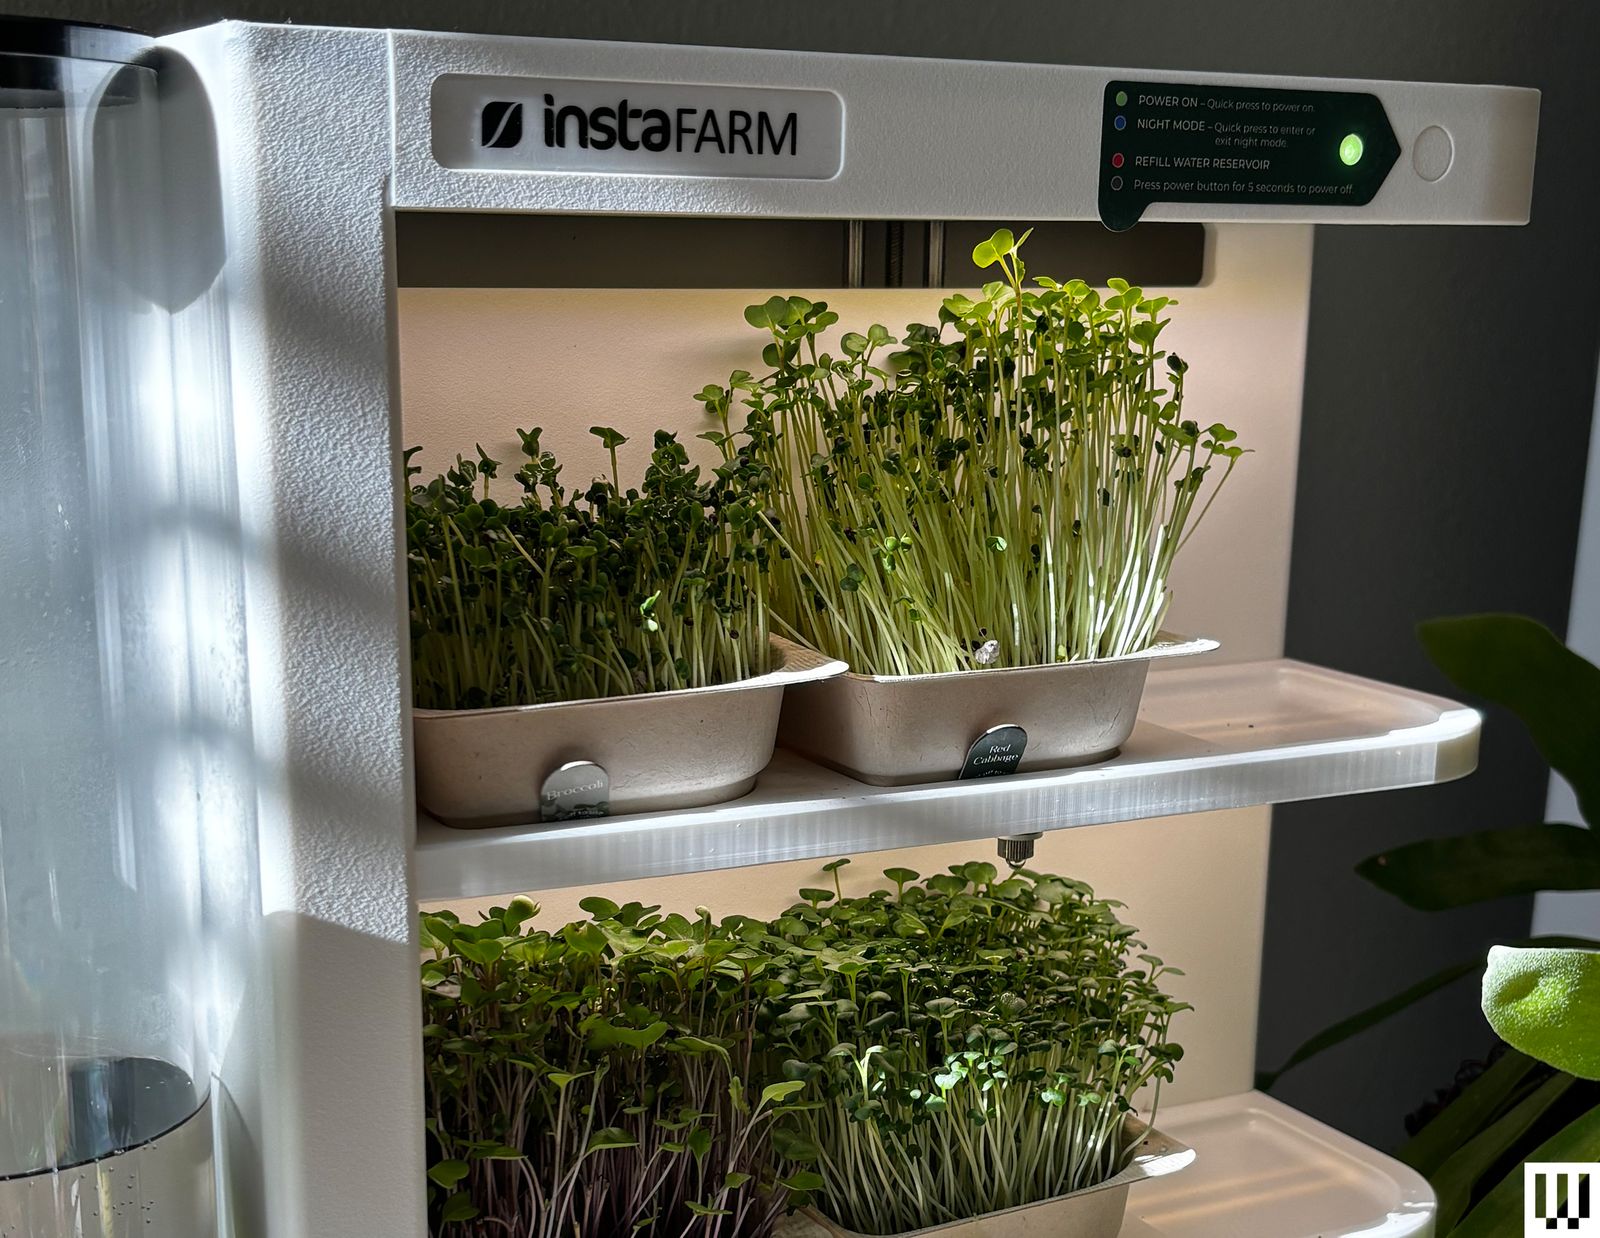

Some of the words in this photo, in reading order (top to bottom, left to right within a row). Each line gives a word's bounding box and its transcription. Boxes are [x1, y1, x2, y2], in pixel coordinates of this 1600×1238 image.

[1138, 95, 1179, 107] POWER
[1181, 97, 1198, 107] ON
[1207, 98, 1234, 109] Quick
[1235, 102, 1260, 112] press
[1261, 102, 1271, 111] to
[1272, 104, 1301, 113] power
[544, 94, 797, 155] instaFARM
[1137, 119, 1171, 130] NIGHT
[1173, 120, 1206, 131] MODE
[1214, 122, 1241, 133] Quick
[1243, 124, 1268, 134] press
[1269, 125, 1279, 134] to
[1280, 126, 1304, 135] enter
[1306, 127, 1316, 135] or
[1215, 136, 1231, 146] exit
[1234, 137, 1259, 149] night
[1135, 156, 1171, 168] REFILL
[1173, 158, 1210, 169] WATER
[1212, 158, 1270, 170] RESERVOIR
[1134, 180, 1161, 191] Press
[1163, 183, 1194, 194] power
[1197, 181, 1230, 191] button
[1232, 181, 1245, 192] for
[1247, 182, 1254, 192] 5
[1255, 183, 1295, 193] seconds
[1297, 184, 1307, 193] to
[1308, 185, 1338, 195] power
[989, 744, 1011, 754] Red
[973, 754, 1019, 766] Cabbage
[546, 779, 603, 801] Broccoli
